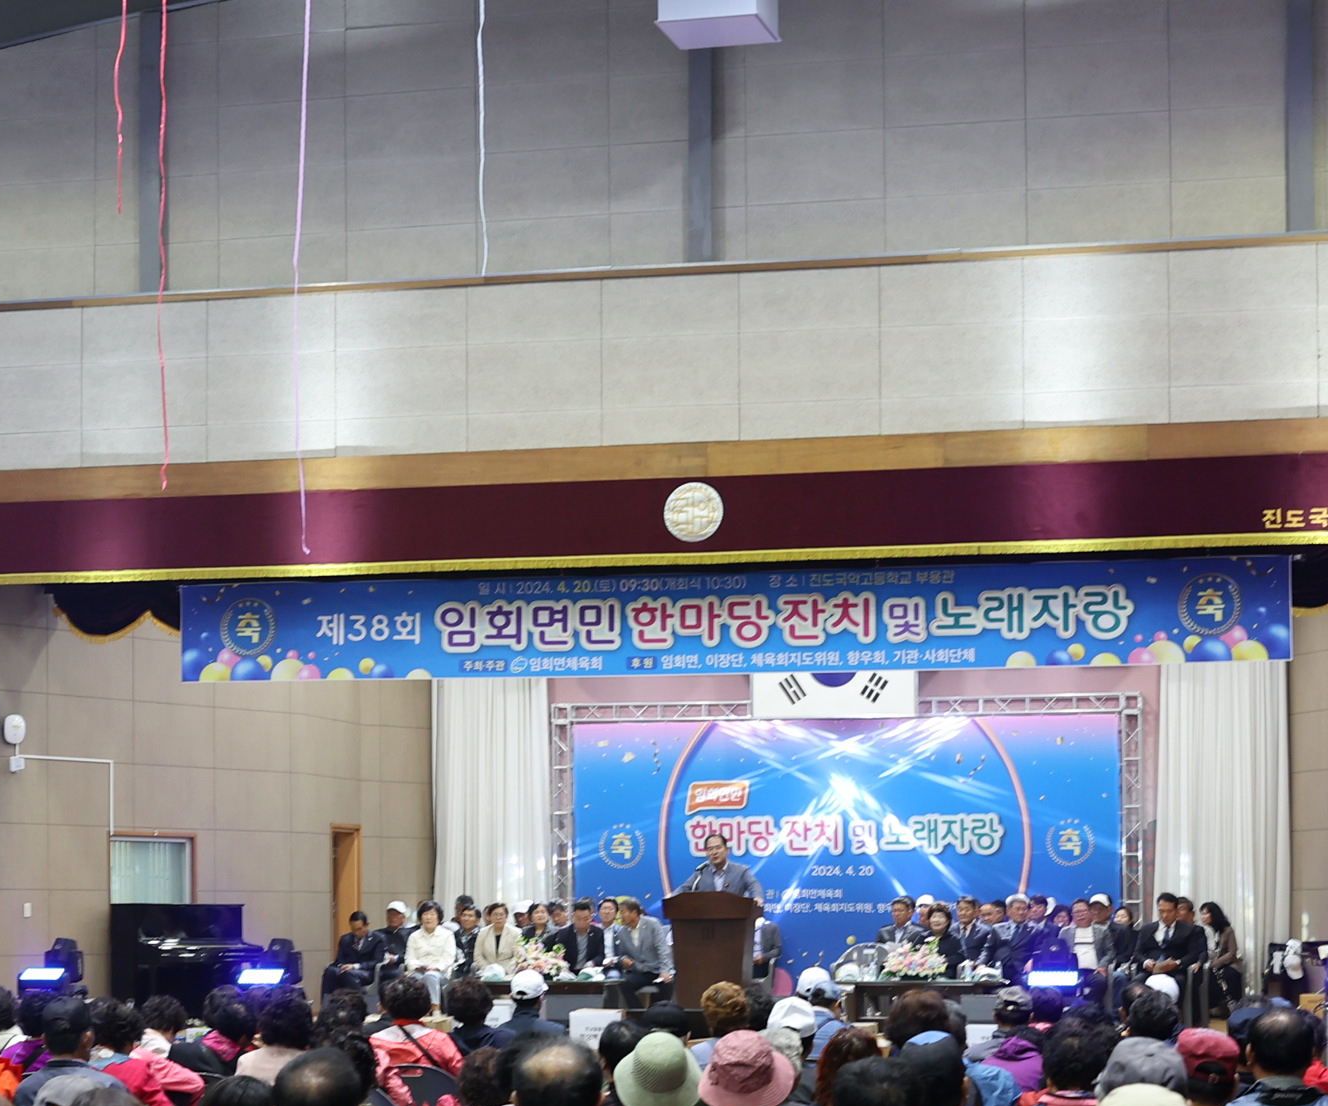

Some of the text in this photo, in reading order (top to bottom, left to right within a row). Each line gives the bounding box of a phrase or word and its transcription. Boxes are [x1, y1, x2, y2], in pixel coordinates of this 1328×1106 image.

[315, 583, 1135, 653] 제38회 임회면민 한마당 잔치 및 노래자랑
[1194, 588, 1225, 624] 축
[234, 612, 263, 645] 축
[784, 816, 841, 852] 잔치
[851, 821, 875, 853] 및
[883, 815, 1002, 852] 노래자랑
